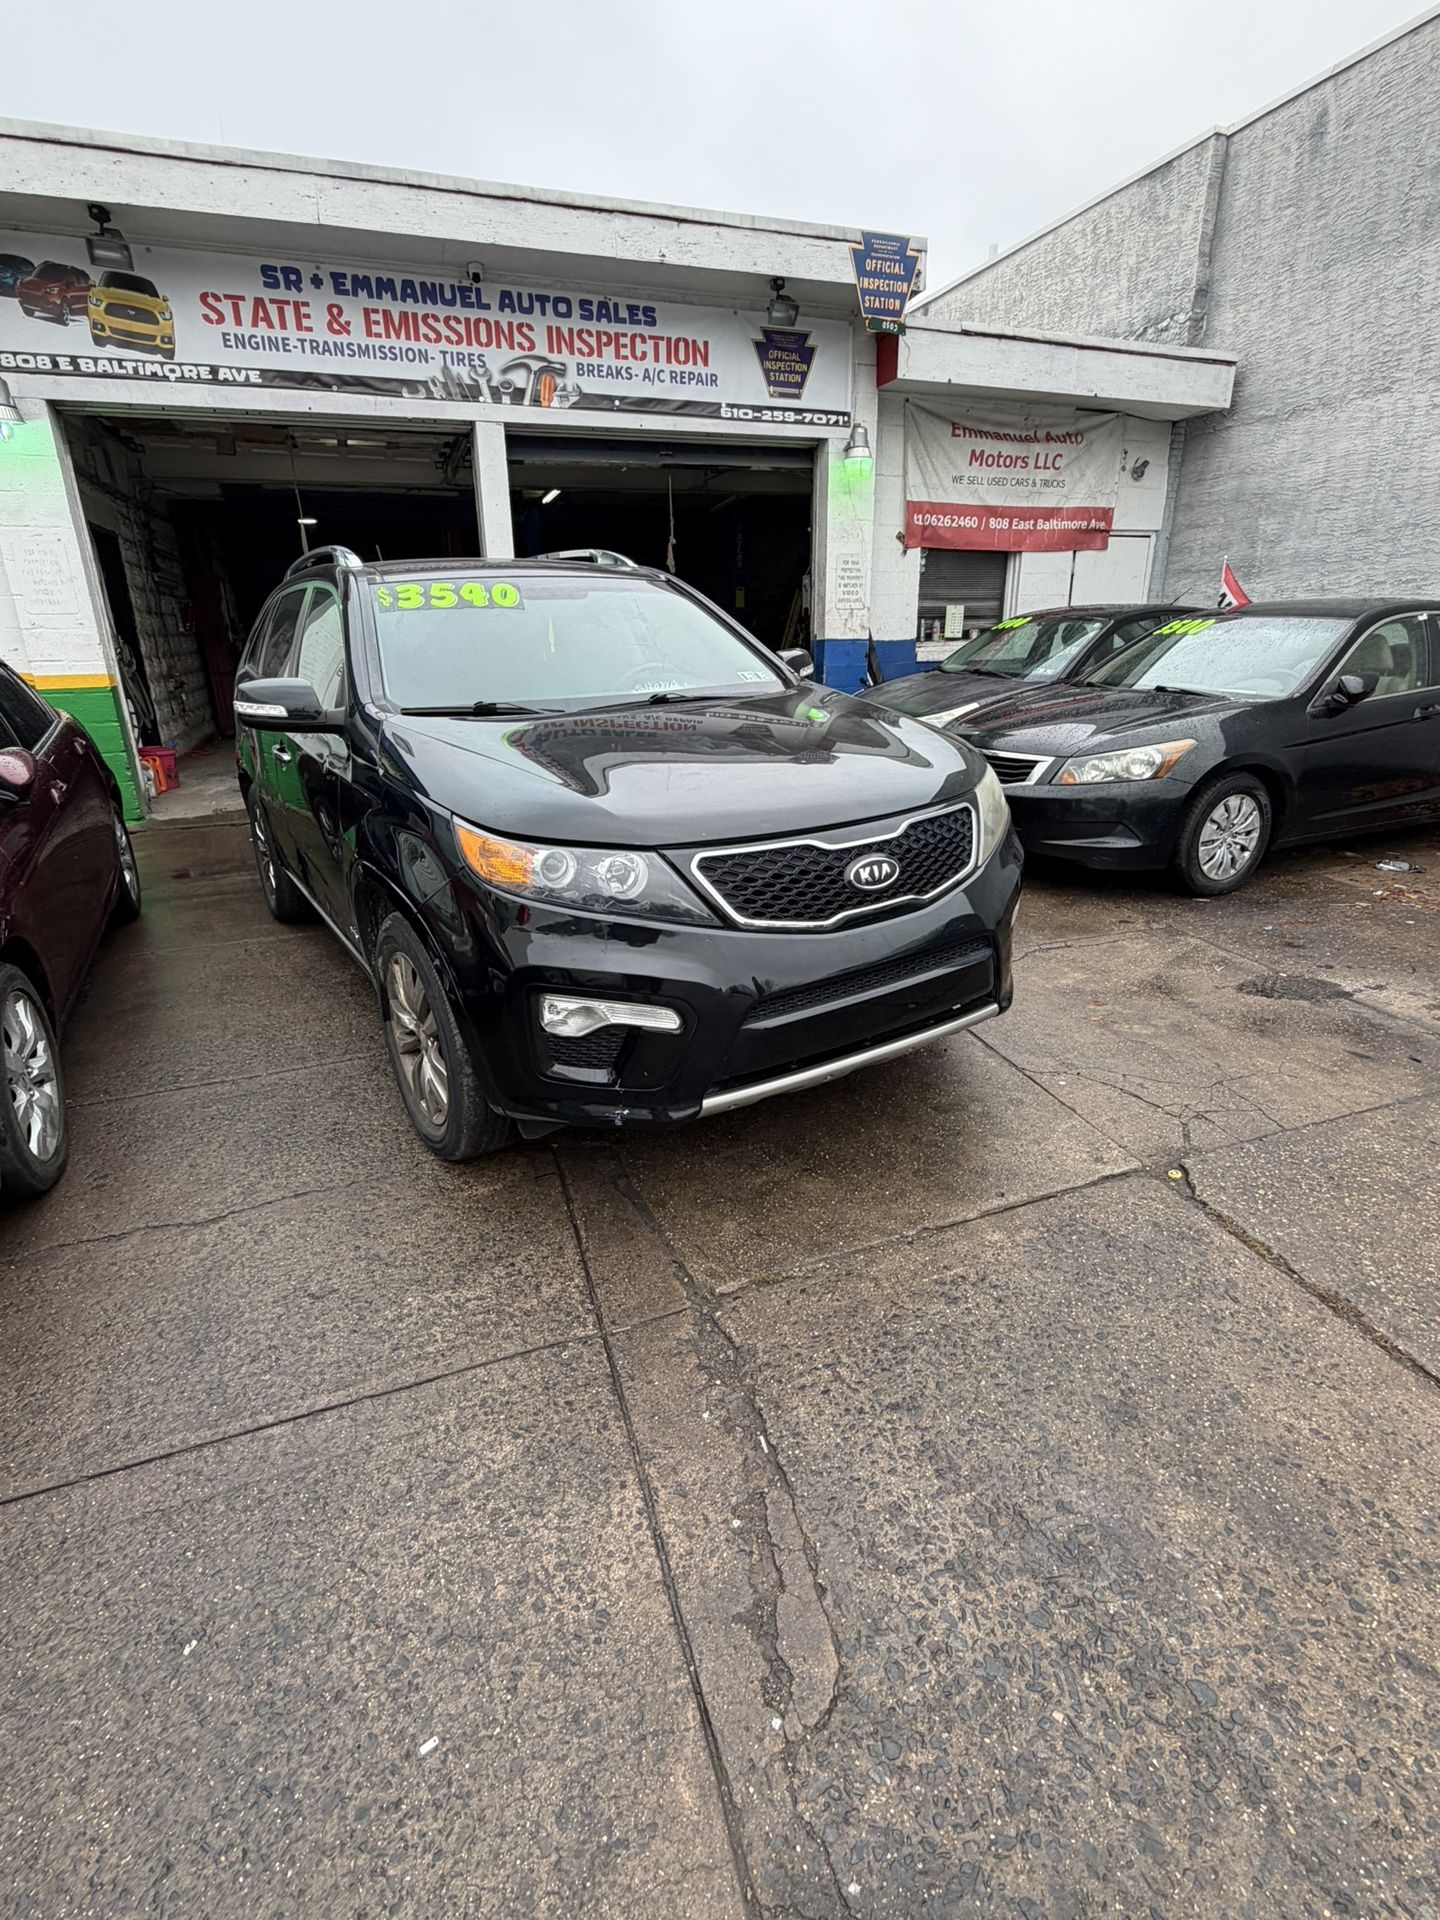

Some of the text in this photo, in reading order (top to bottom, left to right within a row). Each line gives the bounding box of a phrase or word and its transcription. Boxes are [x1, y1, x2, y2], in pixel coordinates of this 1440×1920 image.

[865, 258, 905, 275] OFFICIAL
[860, 277, 908, 294] INSPECTION
[259, 264, 304, 293] SR
[329, 271, 491, 311] EMMANUEL
[498, 289, 573, 319] AUTO
[578, 298, 657, 327] SALES
[864, 296, 901, 311] STATION
[199, 291, 709, 368] STATE & EMISSIONS INSPECTION
[768, 350, 801, 361] OFFICIAL
[0, 353, 52, 369] 808
[53, 356, 74, 371] E
[218, 367, 263, 383] AVE
[439, 350, 487, 369] TIRES
[576, 362, 639, 381] BREAKS-
[642, 367, 666, 385] A/C
[670, 370, 719, 387] REPAIR
[763, 360, 808, 373] INSPECTION
[769, 372, 802, 383] STATION
[721, 407, 844, 425] 610-259-7071
[951, 421, 1084, 446] Emmanuel Auto
[968, 449, 1063, 471] Motors LLC
[952, 475, 1066, 488] WE SELL USED CARS & TRUCKS
[989, 517, 1009, 529] 808
[1012, 518, 1034, 530] East
[1036, 518, 1087, 531] Baltimore
[1088, 518, 1105, 530] Ave
[376, 582, 520, 609] $3540
[858, 862, 891, 884] KIA
